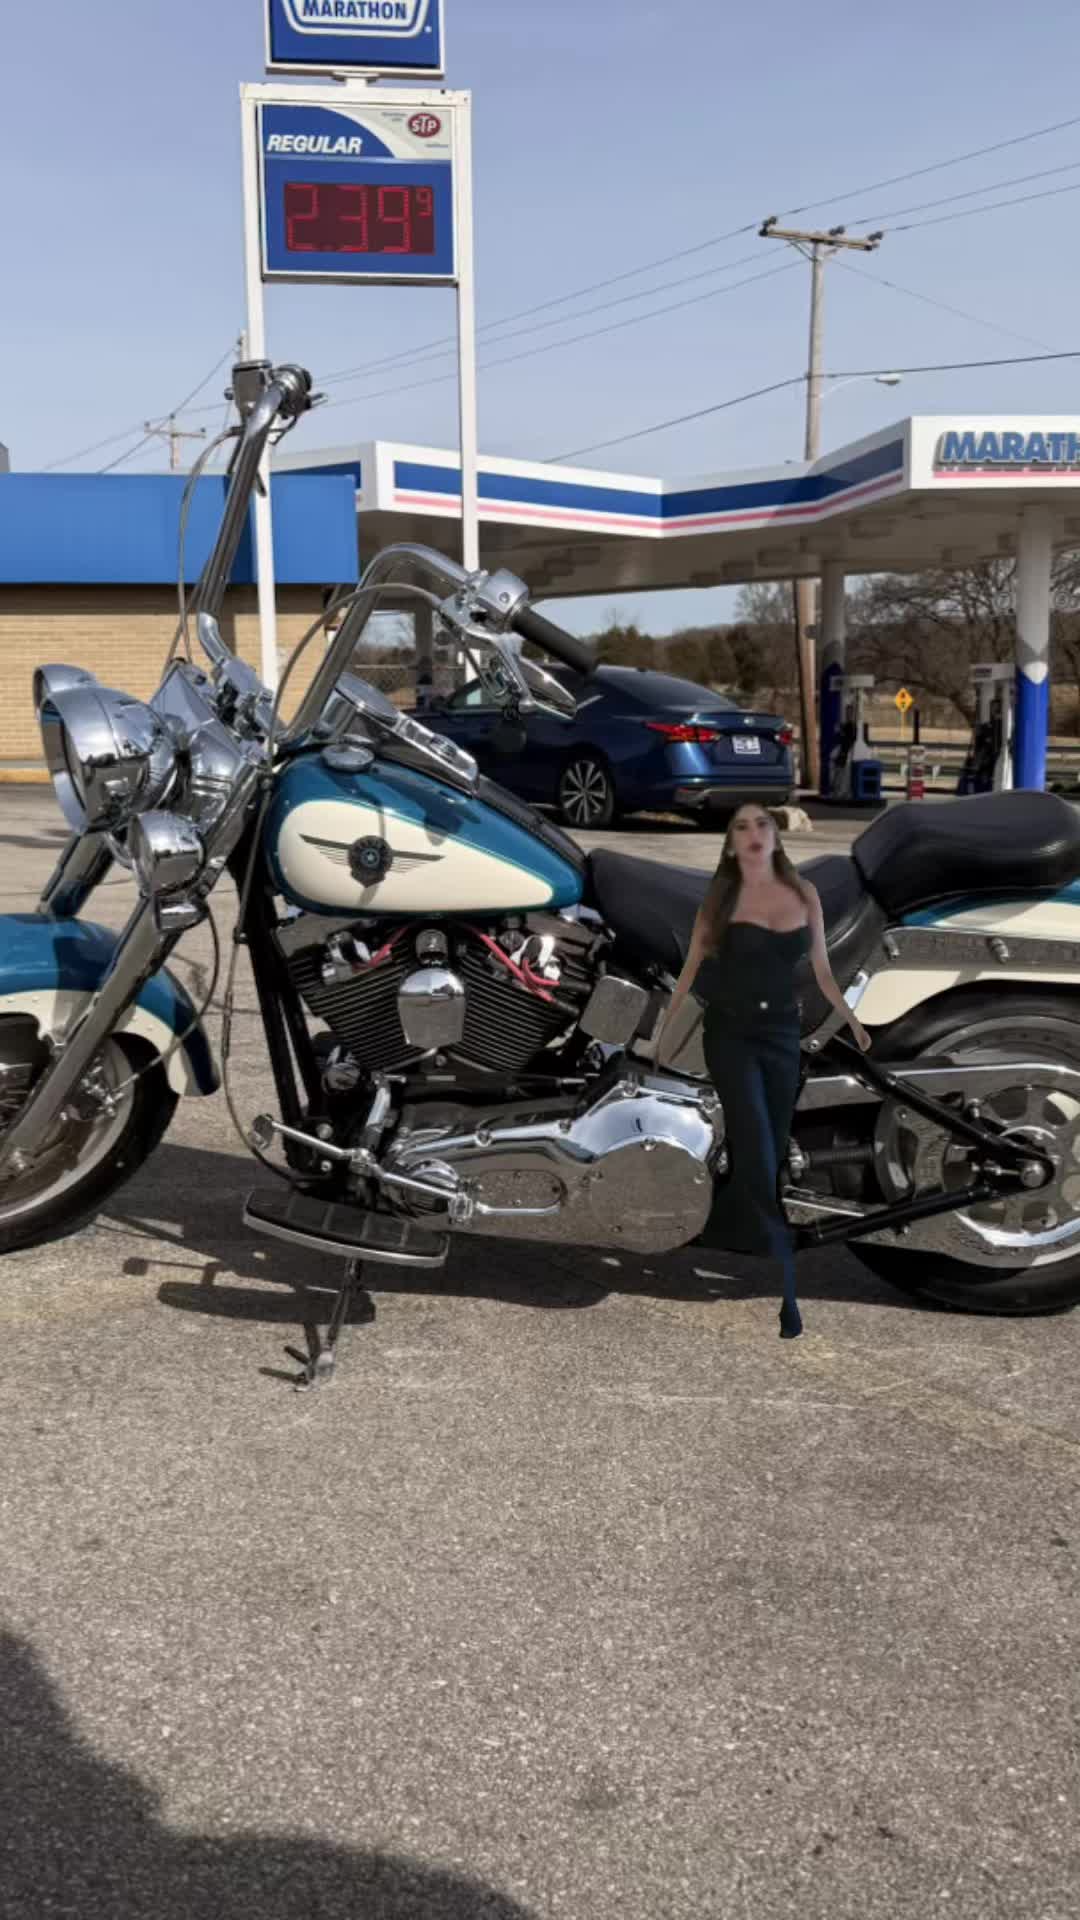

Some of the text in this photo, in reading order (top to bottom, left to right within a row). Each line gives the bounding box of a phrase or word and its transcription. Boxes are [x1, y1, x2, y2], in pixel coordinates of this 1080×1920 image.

[302, 0, 406, 19] MARATHON
[412, 113, 438, 133] STP
[267, 134, 363, 154] REGULAR
